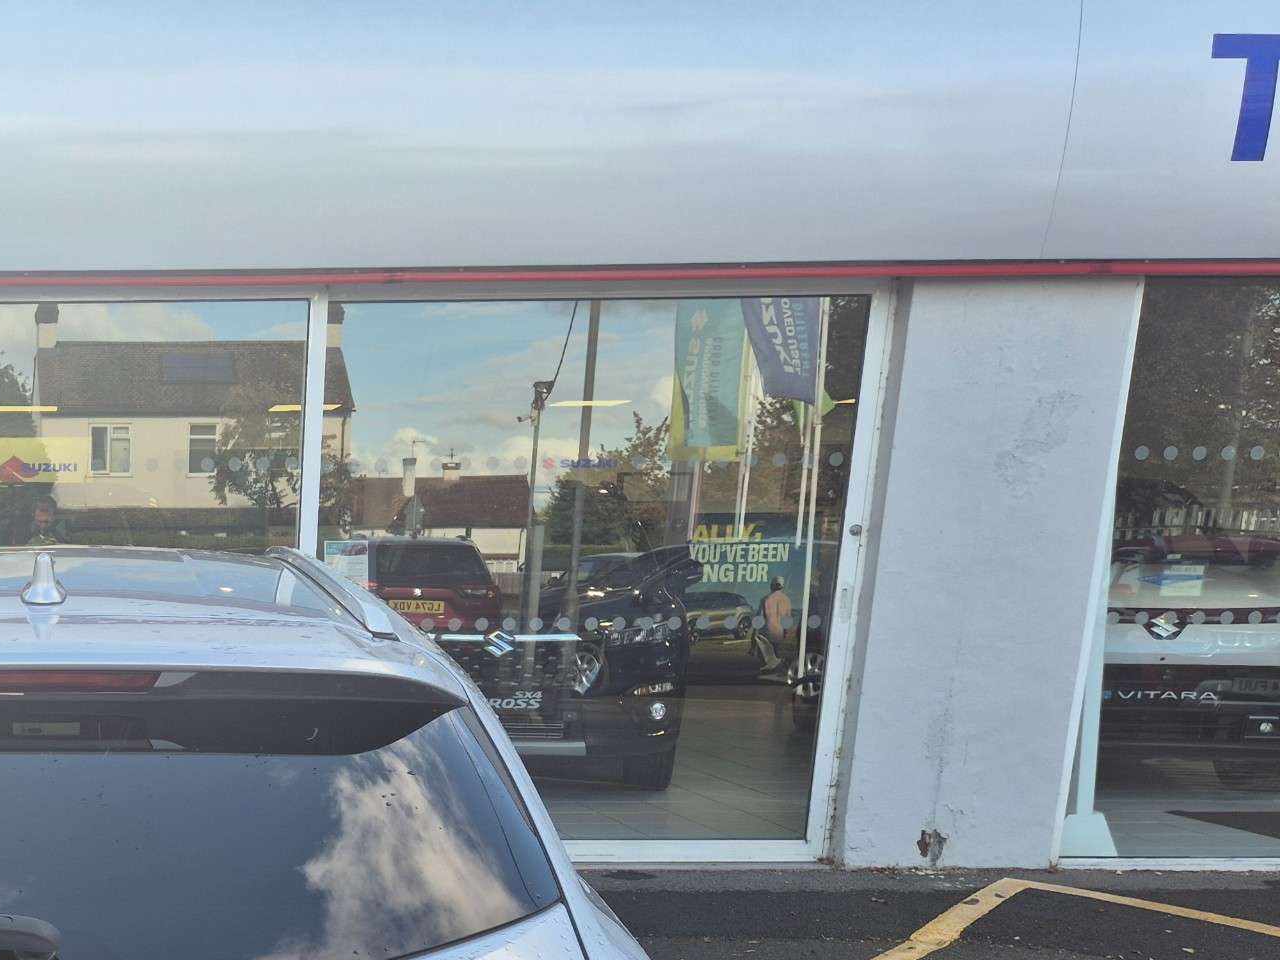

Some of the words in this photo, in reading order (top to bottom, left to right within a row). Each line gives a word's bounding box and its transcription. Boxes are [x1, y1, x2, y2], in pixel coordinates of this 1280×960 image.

[1211, 33, 1280, 162] T
[22, 462, 78, 473] SUZUKI
[689, 543, 745, 563] YOU'VE
[748, 543, 790, 562] BEEN
[699, 564, 735, 583] NG
[736, 564, 769, 583] FOR
[512, 690, 544, 699] SX4
[1117, 689, 1218, 701] VITARA
